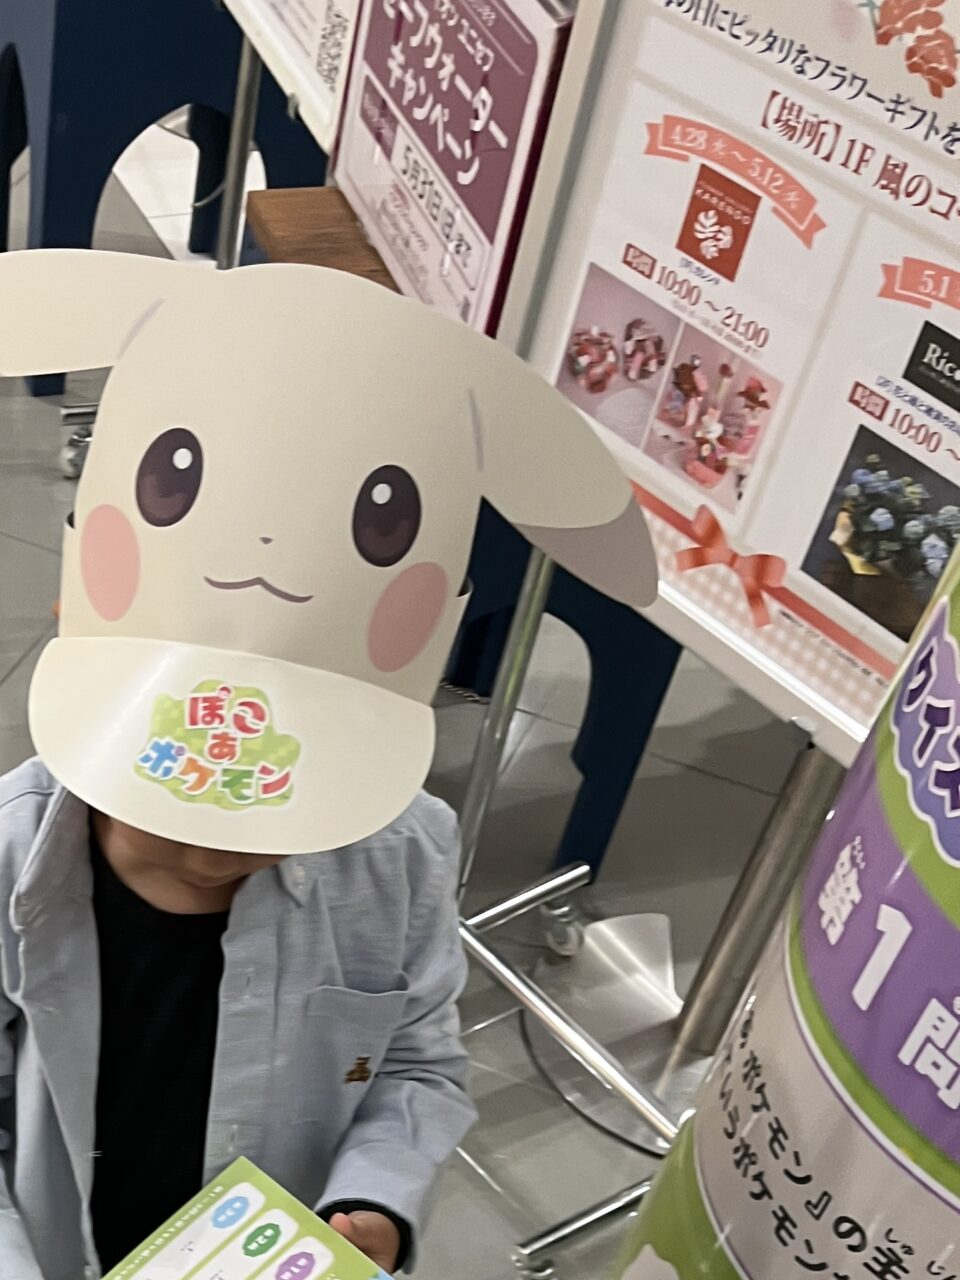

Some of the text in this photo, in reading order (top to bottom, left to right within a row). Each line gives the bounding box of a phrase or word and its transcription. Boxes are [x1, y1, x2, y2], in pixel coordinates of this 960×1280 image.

[386, 42, 479, 185] キャンペーン
[188, 685, 267, 735] ぽこ
[138, 739, 291, 801] ポケモン
[207, 731, 237, 761] あ
